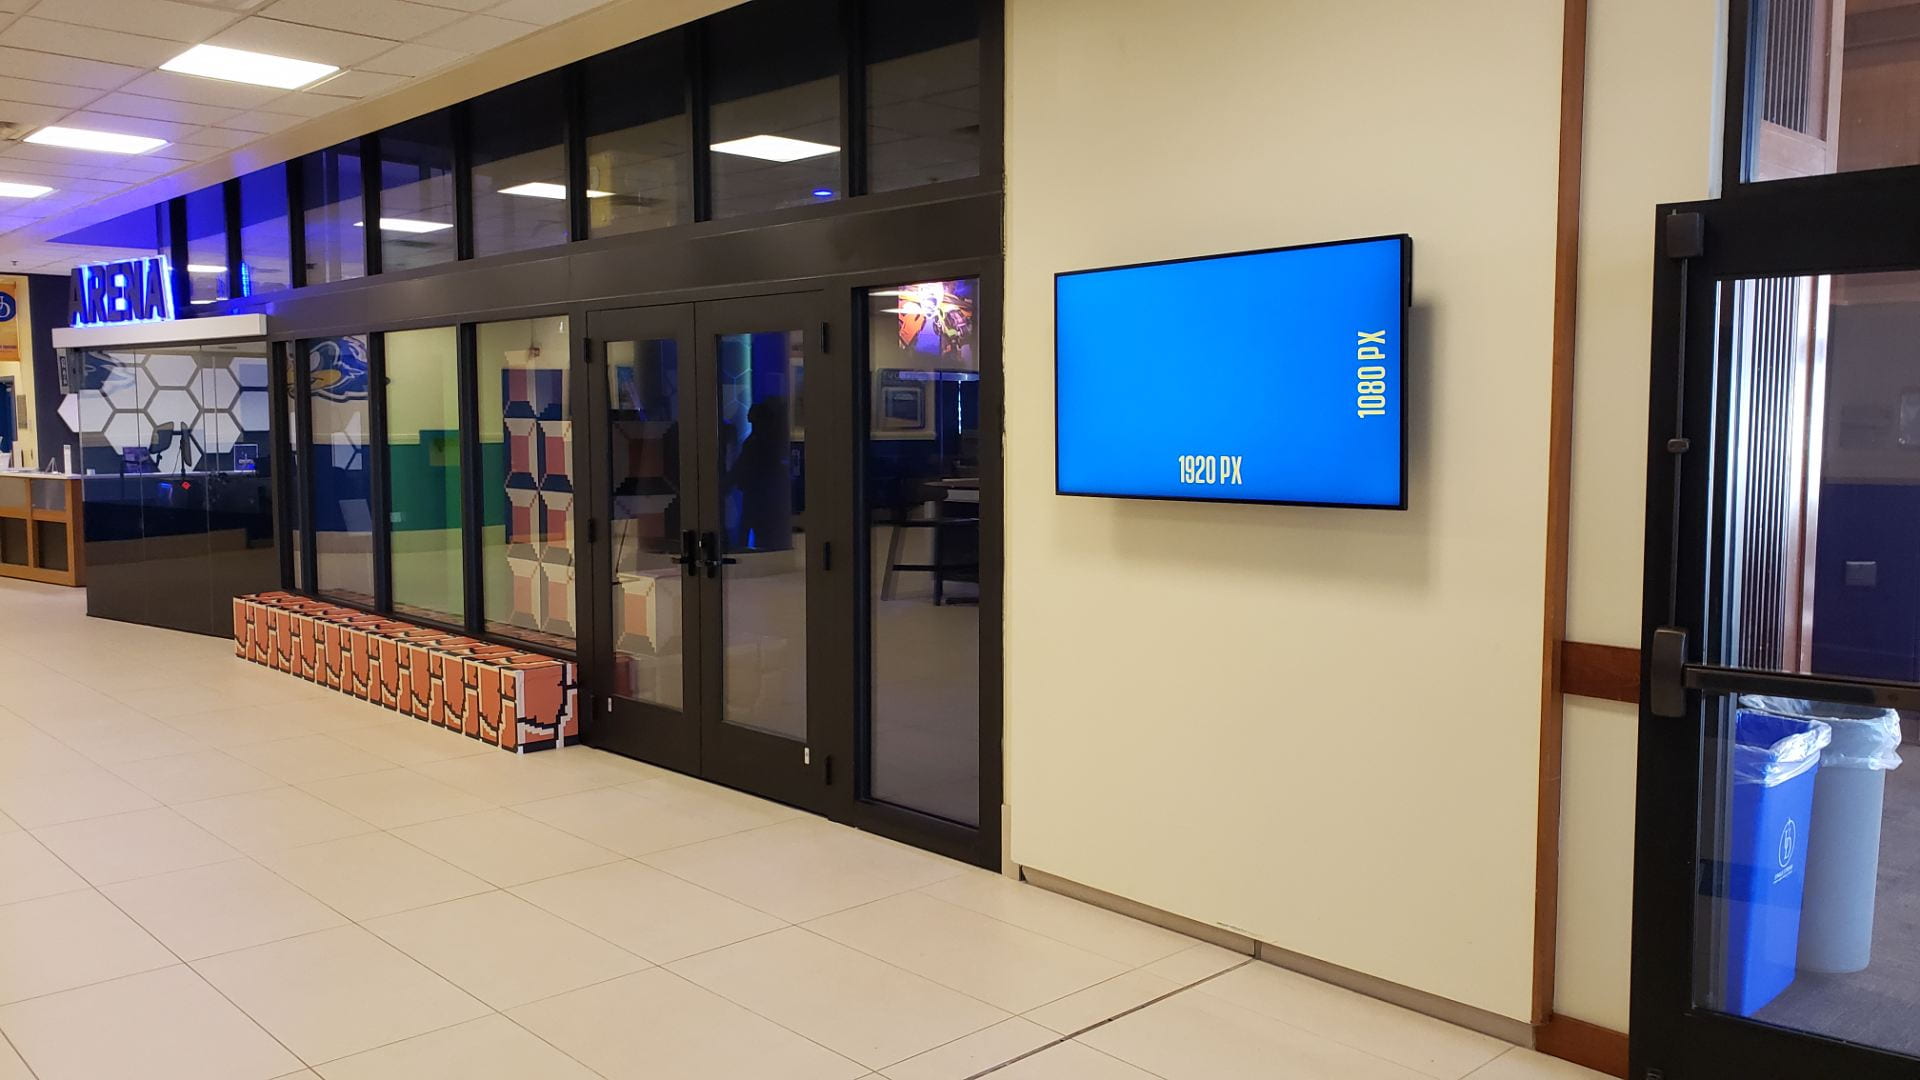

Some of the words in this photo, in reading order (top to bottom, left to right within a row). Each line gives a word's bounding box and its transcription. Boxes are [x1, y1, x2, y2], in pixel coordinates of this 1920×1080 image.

[69, 256, 170, 327] ARENA
[1357, 330, 1386, 361] PX
[1357, 366, 1386, 418] 1080
[1178, 455, 1216, 484] 1920
[1220, 455, 1243, 485] PX
